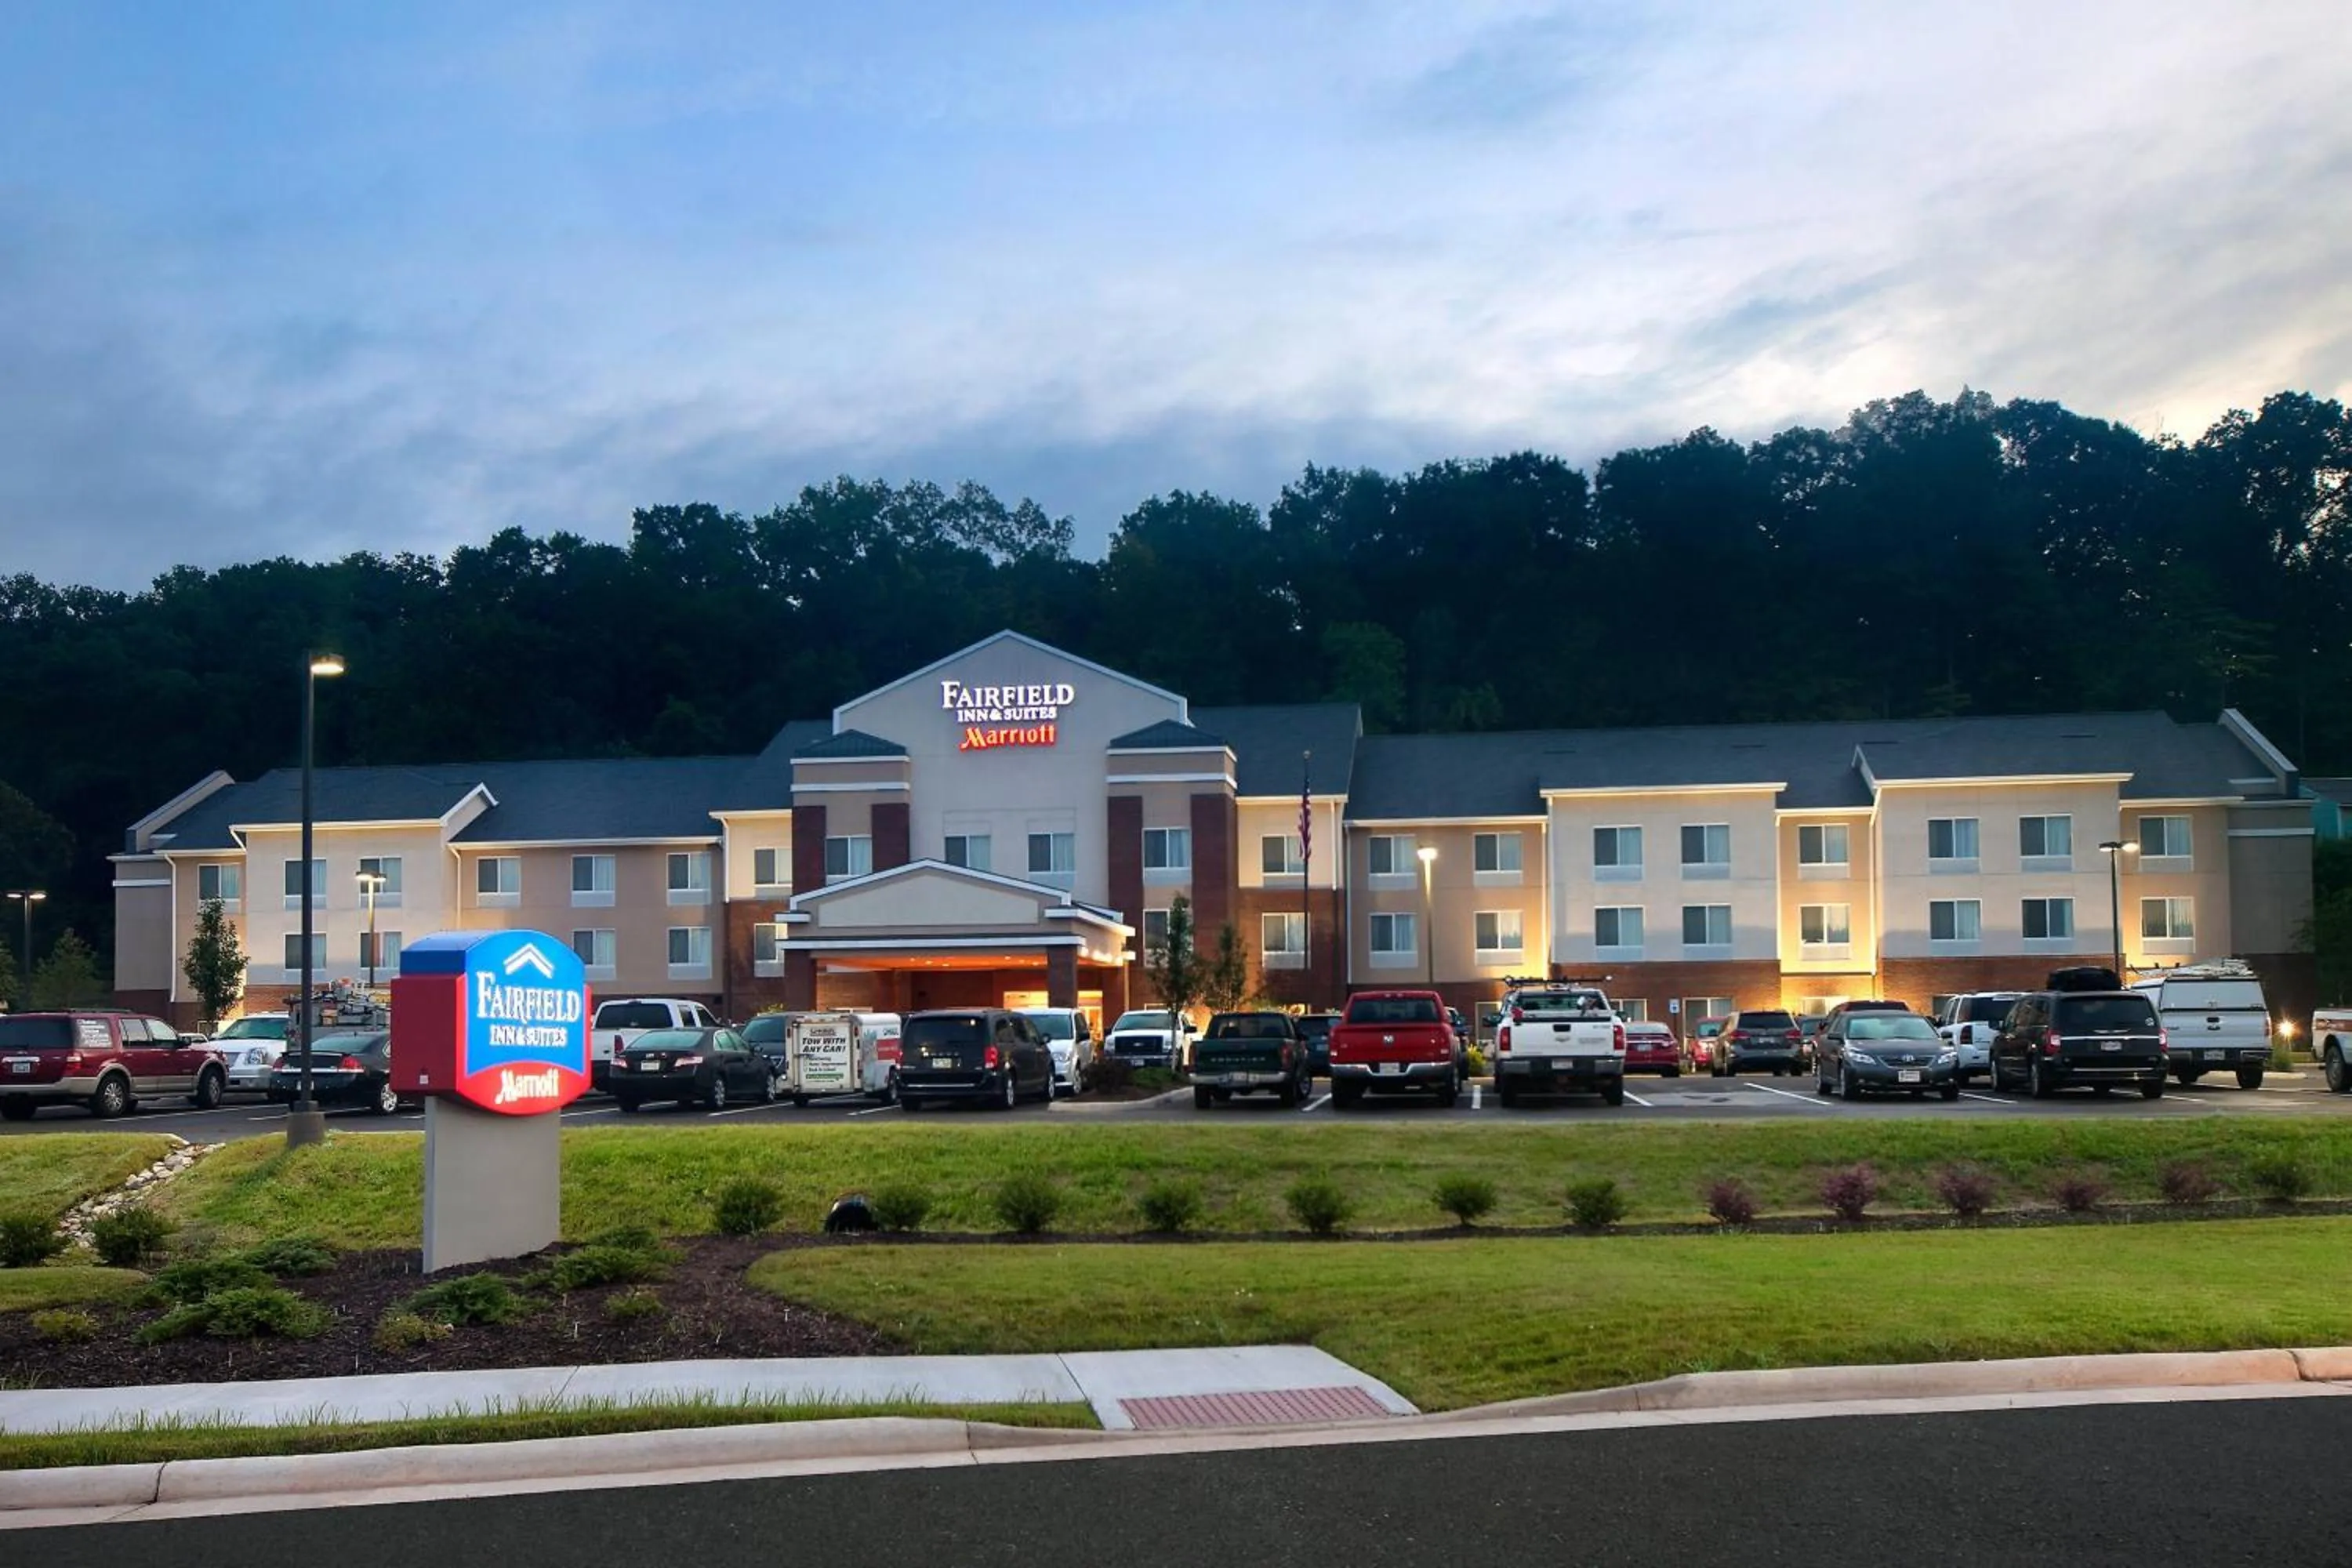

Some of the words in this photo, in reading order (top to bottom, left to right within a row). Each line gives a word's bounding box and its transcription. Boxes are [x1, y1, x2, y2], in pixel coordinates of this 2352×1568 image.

[941, 681, 1075, 709] FAIRFIELD
[959, 724, 1055, 750] Marriott
[476, 971, 581, 1024] FAIRFIELD
[495, 1069, 559, 1104] Marriott
